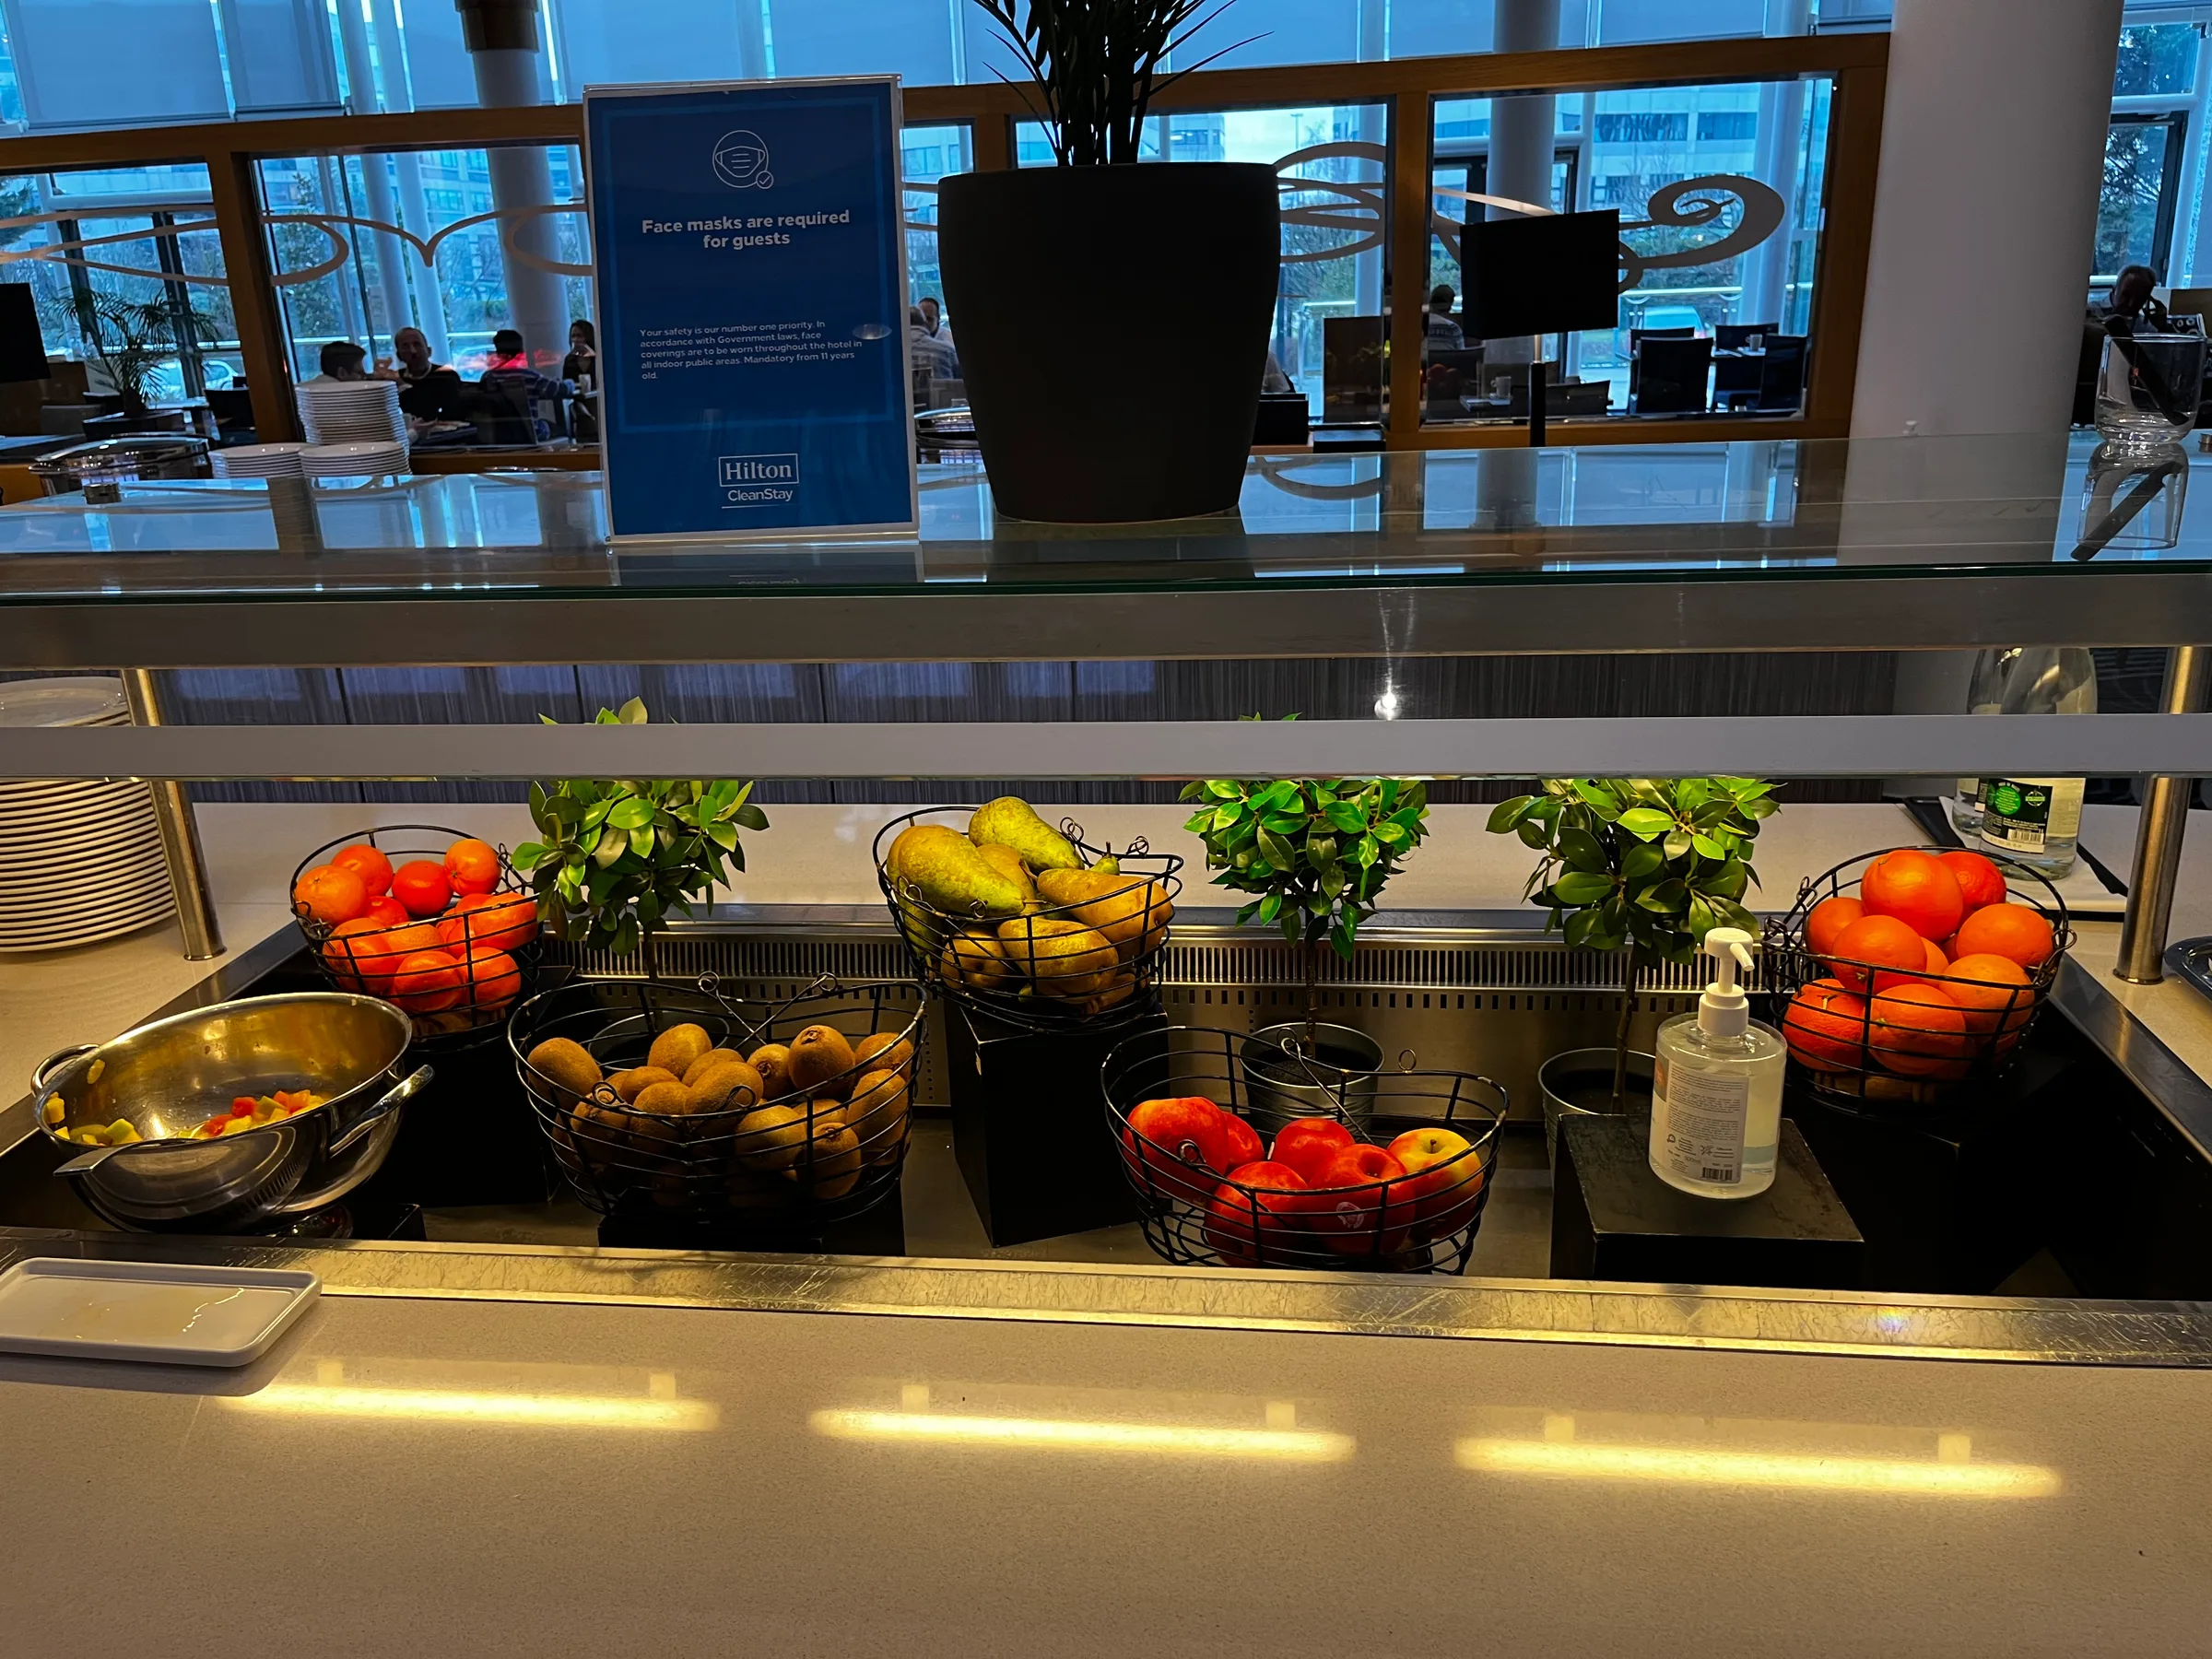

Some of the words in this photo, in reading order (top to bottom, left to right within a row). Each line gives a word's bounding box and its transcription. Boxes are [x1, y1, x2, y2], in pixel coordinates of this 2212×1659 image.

[641, 219, 683, 233] Face
[688, 216, 742, 231] masks
[747, 217, 773, 229] are
[778, 209, 850, 229] required
[703, 235, 728, 248] for
[733, 232, 791, 250] guests
[664, 327, 692, 336] safety
[721, 324, 758, 333] number
[641, 338, 694, 347] accordance
[717, 334, 775, 344] Government
[641, 349, 686, 359] coverings
[755, 343, 807, 353] throughout
[653, 360, 683, 369] indoor
[685, 359, 713, 368] public
[744, 354, 794, 364] Mandatory
[796, 353, 819, 361] from
[830, 352, 855, 361] years
[725, 462, 793, 480] Hilton
[727, 488, 793, 501] CleanStay
